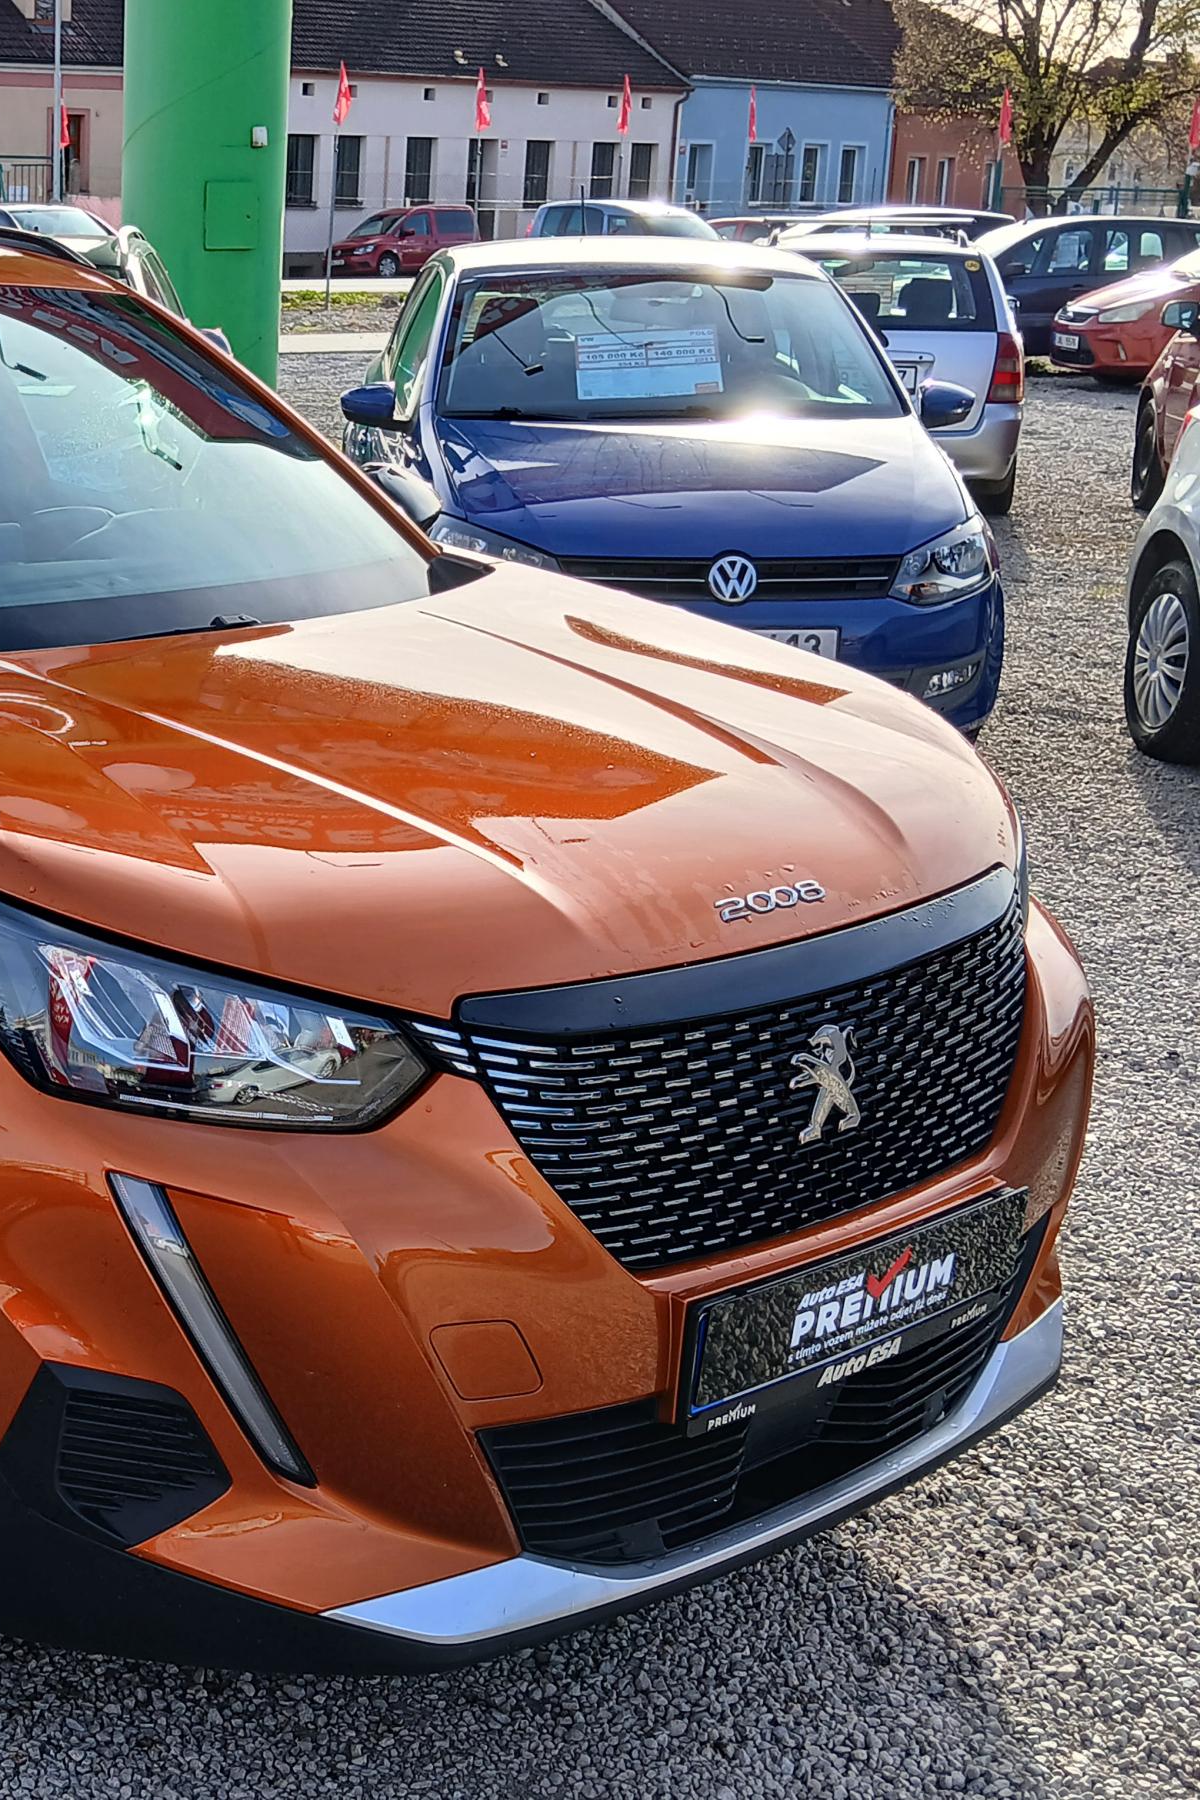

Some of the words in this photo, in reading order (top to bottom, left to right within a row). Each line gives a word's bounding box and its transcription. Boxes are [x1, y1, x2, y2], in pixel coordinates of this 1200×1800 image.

[714, 879, 826, 923] 2008
[789, 1252, 956, 1348] PREMIUM
[823, 1329, 854, 1349] vozem
[926, 1290, 948, 1306] dnes
[951, 1303, 988, 1329] PREMIUM
[707, 1403, 756, 1431] PREMIUM
